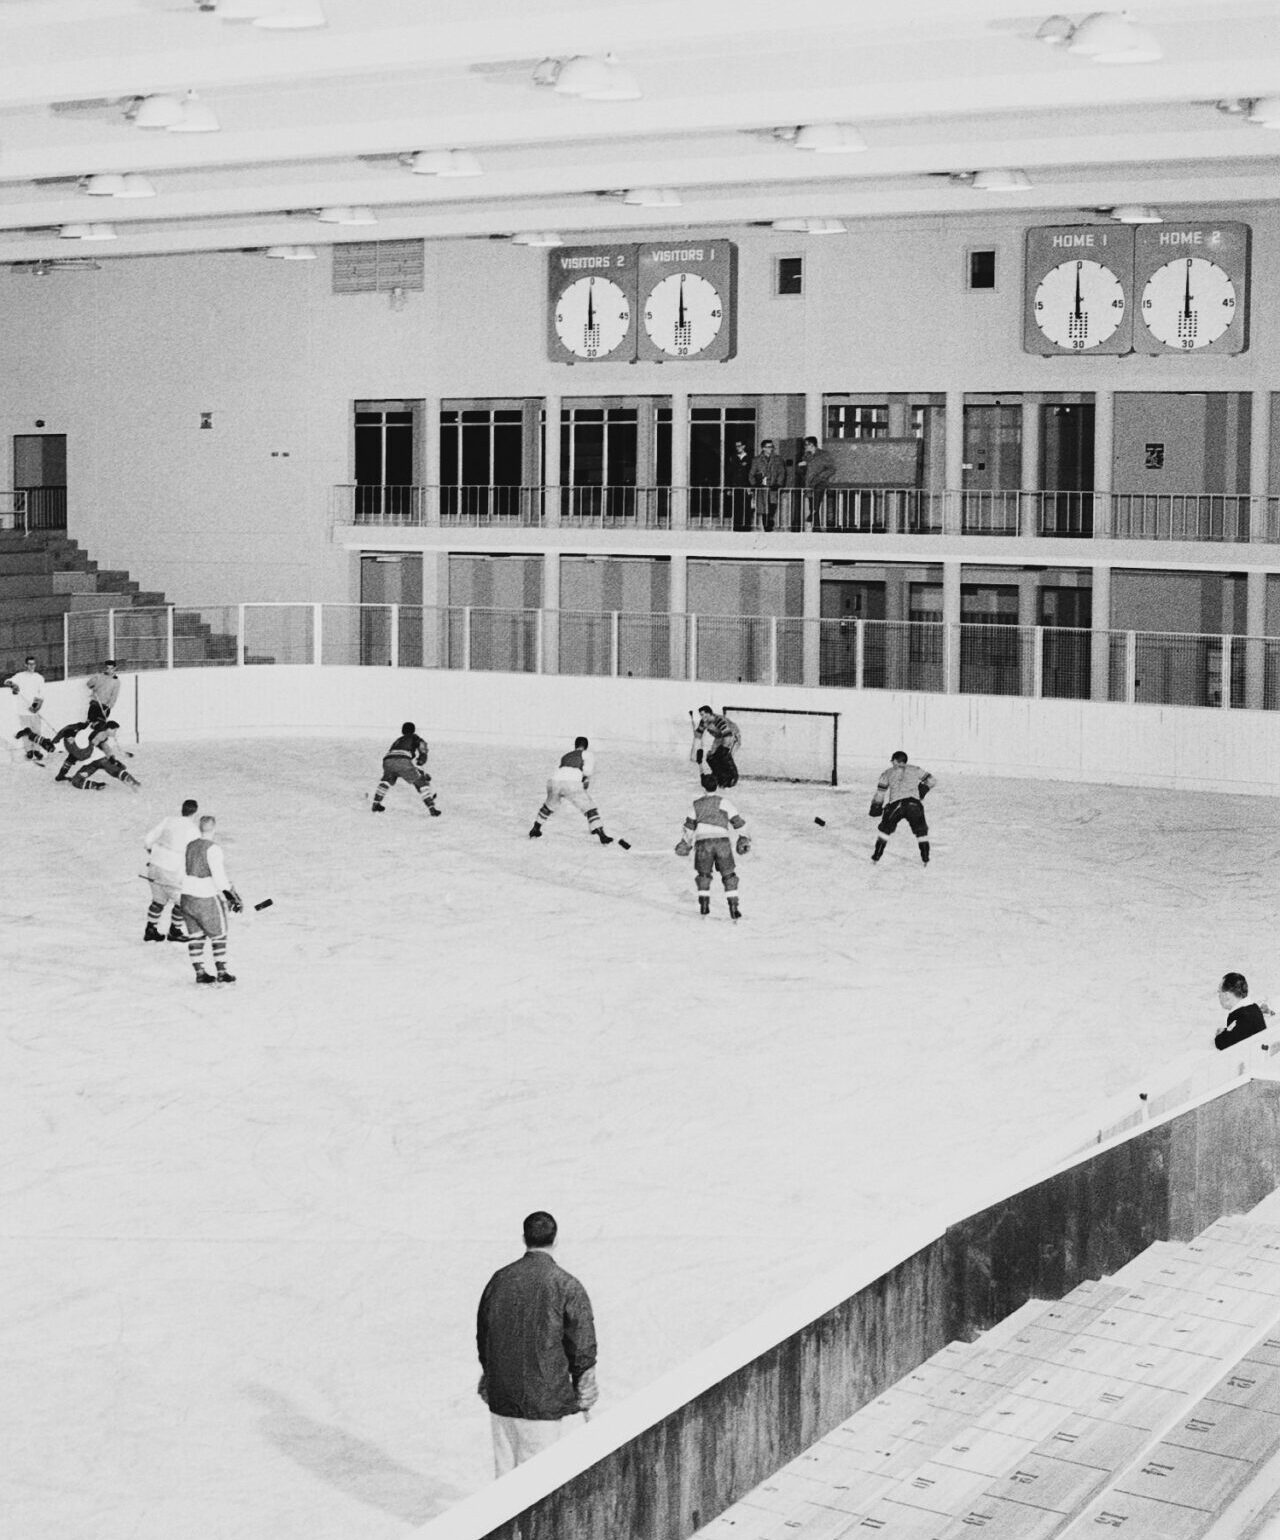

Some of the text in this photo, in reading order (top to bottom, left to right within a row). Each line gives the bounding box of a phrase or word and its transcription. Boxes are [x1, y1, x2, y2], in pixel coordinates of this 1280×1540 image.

[1053, 234, 1107, 247] HOME 1
[1160, 231, 1221, 244] HOME 2
[652, 249, 715, 262] VISITORS 1
[561, 256, 625, 269] VISITORS 2
[1111, 299, 1124, 308] 45
[1142, 299, 1152, 308] 15
[1222, 298, 1235, 307] 45
[711, 310, 722, 318] 45
[1073, 340, 1084, 348] 30
[1182, 340, 1193, 348] 30
[1226, 1376, 1256, 1389] 12
[1094, 1511, 1128, 1528] 15
